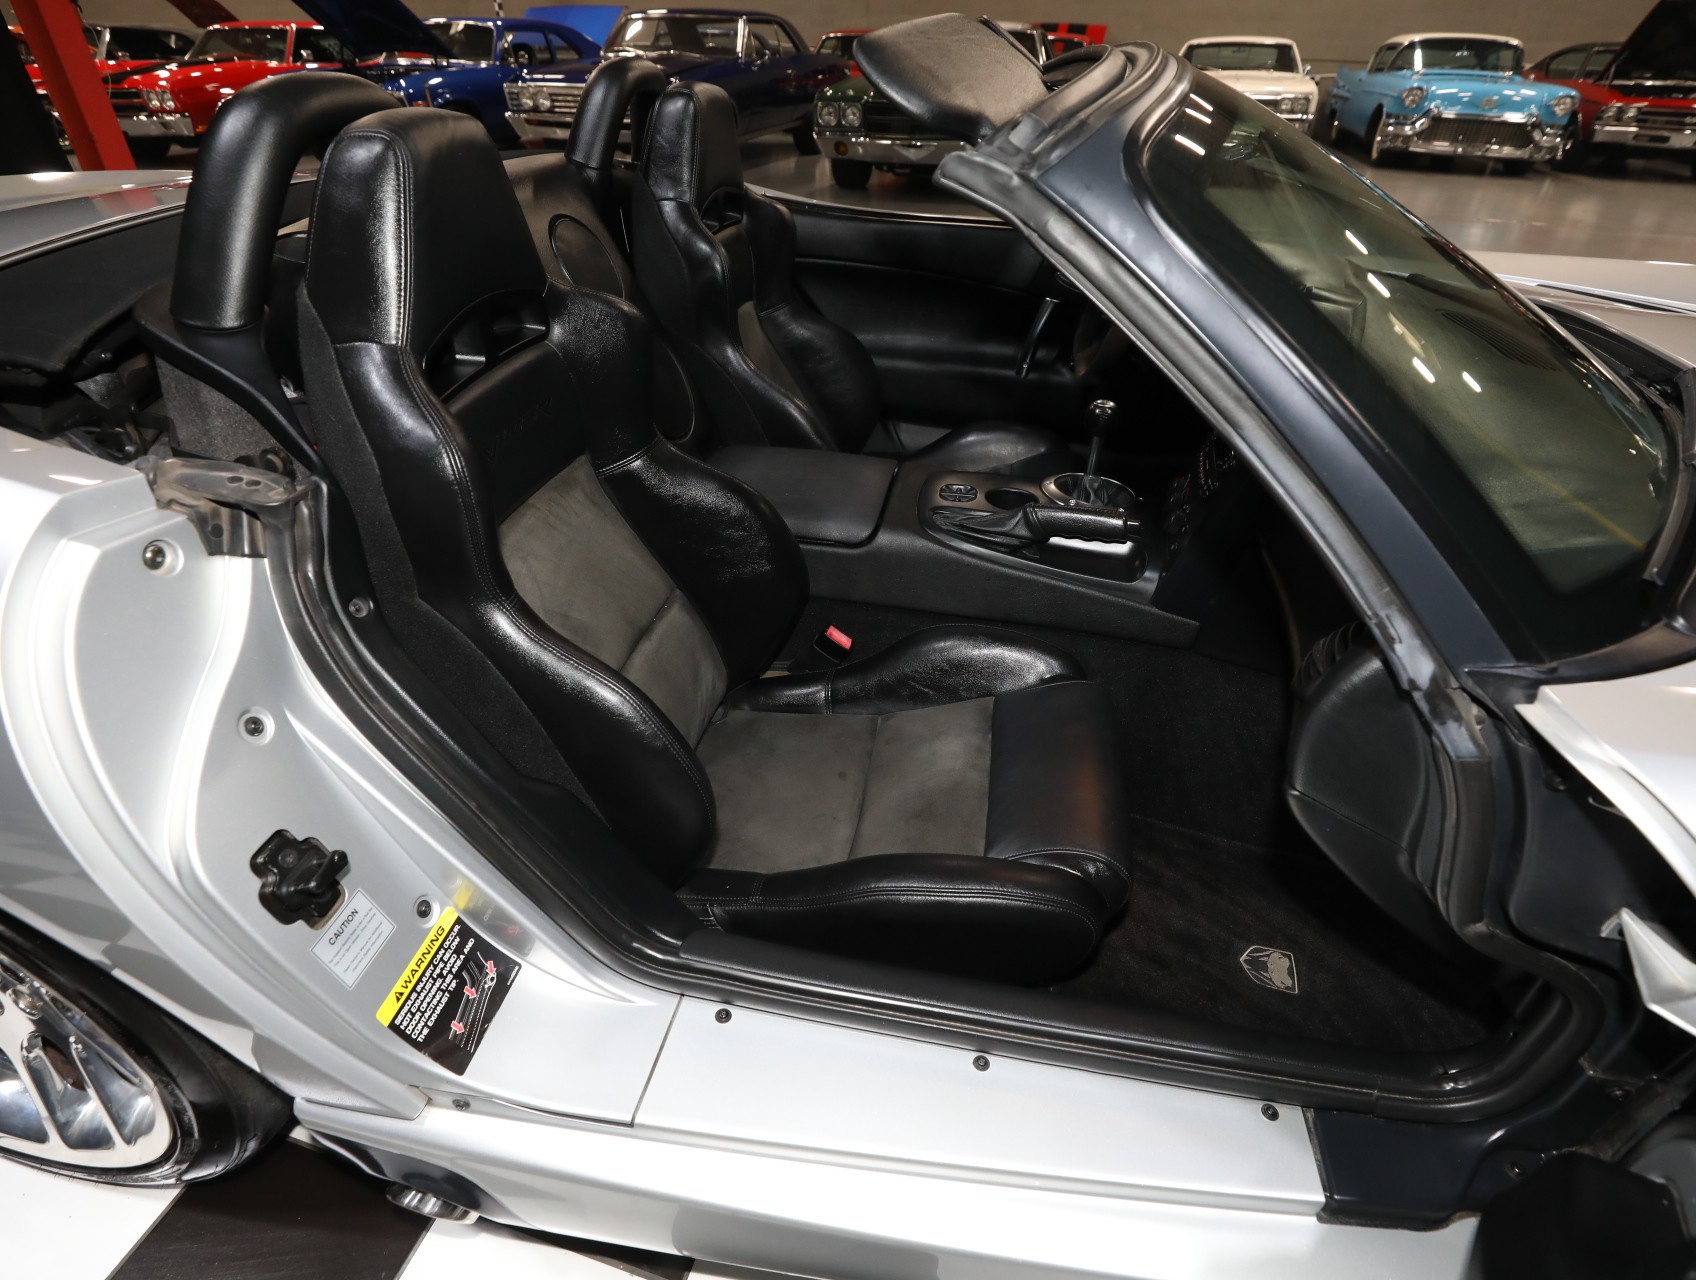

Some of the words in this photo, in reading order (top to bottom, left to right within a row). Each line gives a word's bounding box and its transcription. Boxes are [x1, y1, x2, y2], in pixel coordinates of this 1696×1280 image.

[327, 907, 358, 946] CAUTION
[400, 925, 445, 989] WARNING
[394, 991, 417, 1025] SERIOUS
[415, 964, 435, 992] INJURY
[432, 947, 445, 965] CAN
[442, 922, 461, 949] OCCUR.
[399, 1012, 412, 1030] HOT
[410, 977, 434, 1013] EXHAUST
[432, 960, 445, 978] PIPE
[442, 935, 460, 961] BELOW
[405, 1011, 421, 1034] DOOR
[419, 976, 443, 1011] OPENING.
[441, 953, 457, 976] AVOID
[411, 990, 443, 1039] CONTACTING
[441, 973, 453, 990] THIS
[451, 953, 465, 974] AREA
[462, 937, 475, 954] AND
[417, 1026, 429, 1043] THE
[426, 991, 450, 1026] EXHAUST
[447, 976, 459, 992] TIP.
